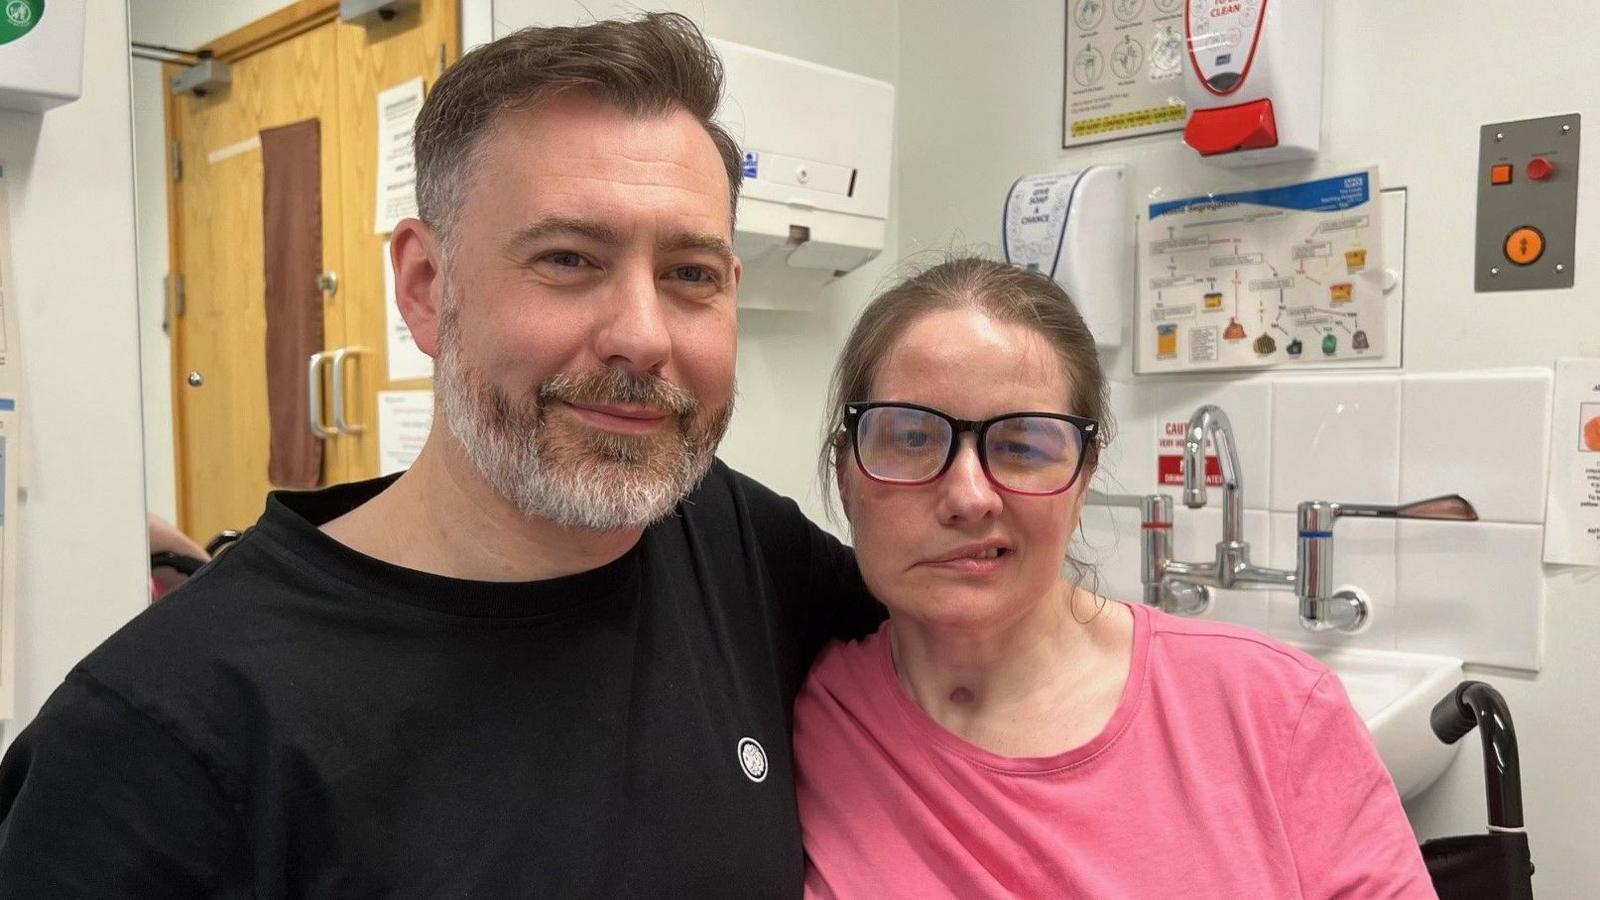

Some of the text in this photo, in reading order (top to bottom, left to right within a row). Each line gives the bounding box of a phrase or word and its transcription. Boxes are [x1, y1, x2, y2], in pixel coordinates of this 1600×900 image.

[1209, 3, 1240, 17] CLEAN
[1021, 214, 1049, 225] CHANCE
[1165, 423, 1189, 434] CAUT
